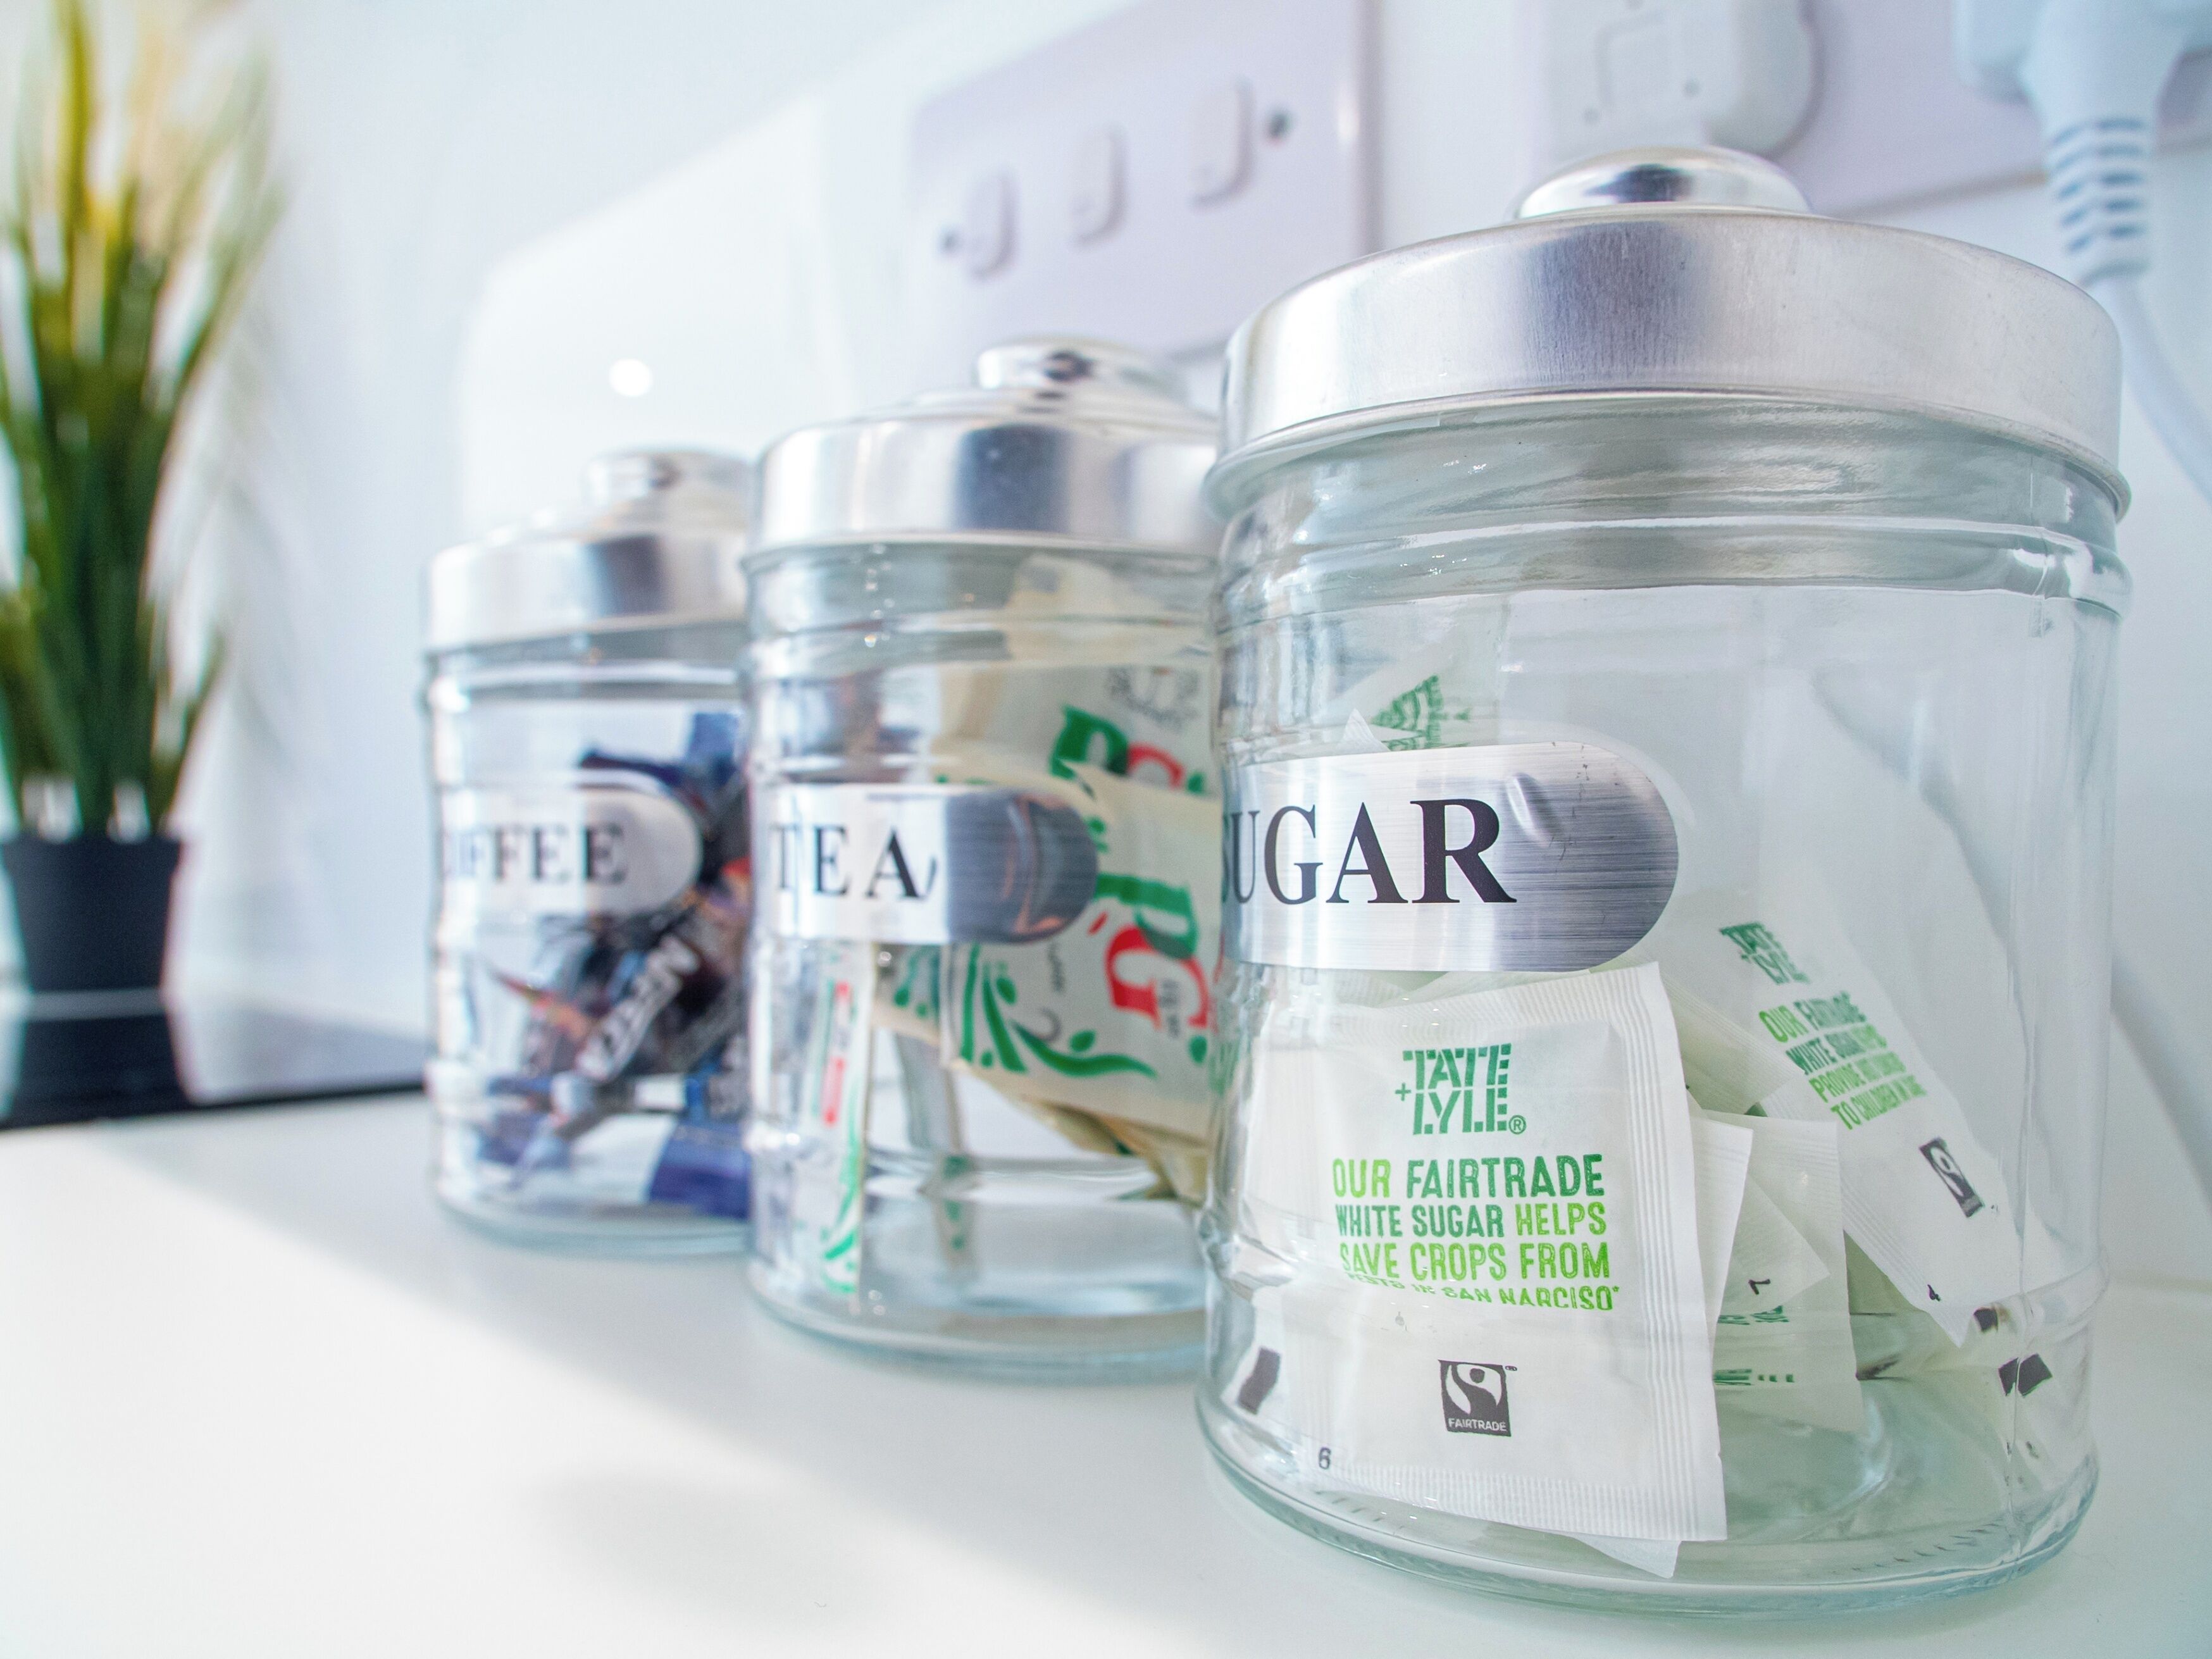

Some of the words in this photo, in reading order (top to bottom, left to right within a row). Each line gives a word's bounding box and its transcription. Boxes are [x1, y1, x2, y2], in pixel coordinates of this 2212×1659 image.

[767, 824, 928, 900] TEA
[1222, 803, 1517, 904] UGAR
[1759, 1005, 1809, 1043] OUR
[1403, 1043, 1512, 1090] TATE
[1786, 1038, 1837, 1075] WHITE
[1830, 1101, 1862, 1130] TO
[1333, 1158, 1391, 1198] OUR
[1407, 1154, 1605, 1198] FAIRTRADE
[1335, 1204, 1403, 1238] WHITE
[1411, 1204, 1505, 1238] SUGAR
[1515, 1202, 1606, 1236] HELPS
[1339, 1242, 1400, 1279] SAVE
[1410, 1242, 1507, 1281] CROPS
[1520, 1241, 1610, 1279] FROM
[1441, 1285, 1492, 1303] SAN
[1447, 1417, 1508, 1432] FAIRTRADE
[1318, 1447, 1332, 1470] 6
